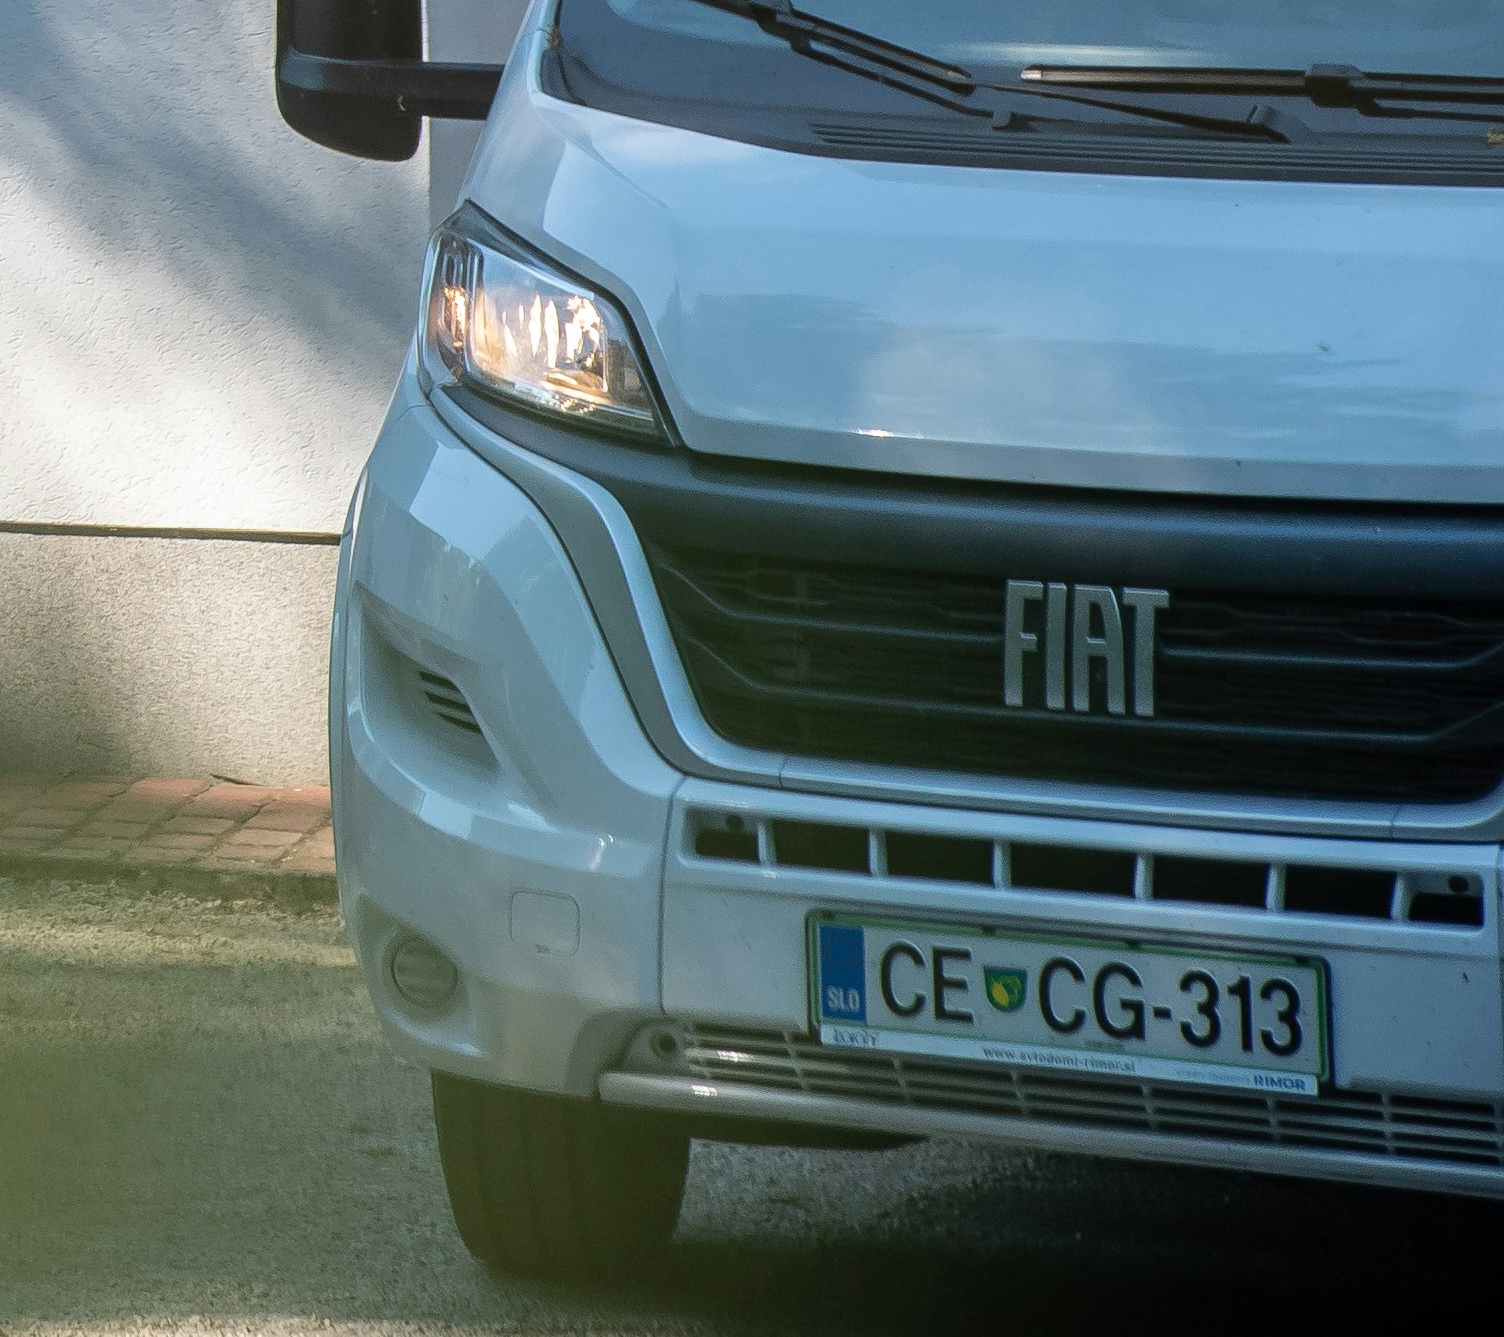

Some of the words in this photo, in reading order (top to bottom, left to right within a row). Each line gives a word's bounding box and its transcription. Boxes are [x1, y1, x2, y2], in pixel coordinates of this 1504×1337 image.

[1004, 578, 1170, 717] FIAT
[827, 985, 860, 1013] SLO
[879, 939, 975, 1025] CE
[1038, 955, 1303, 1058] CG-313
[1252, 1073, 1306, 1092] RIMOR
